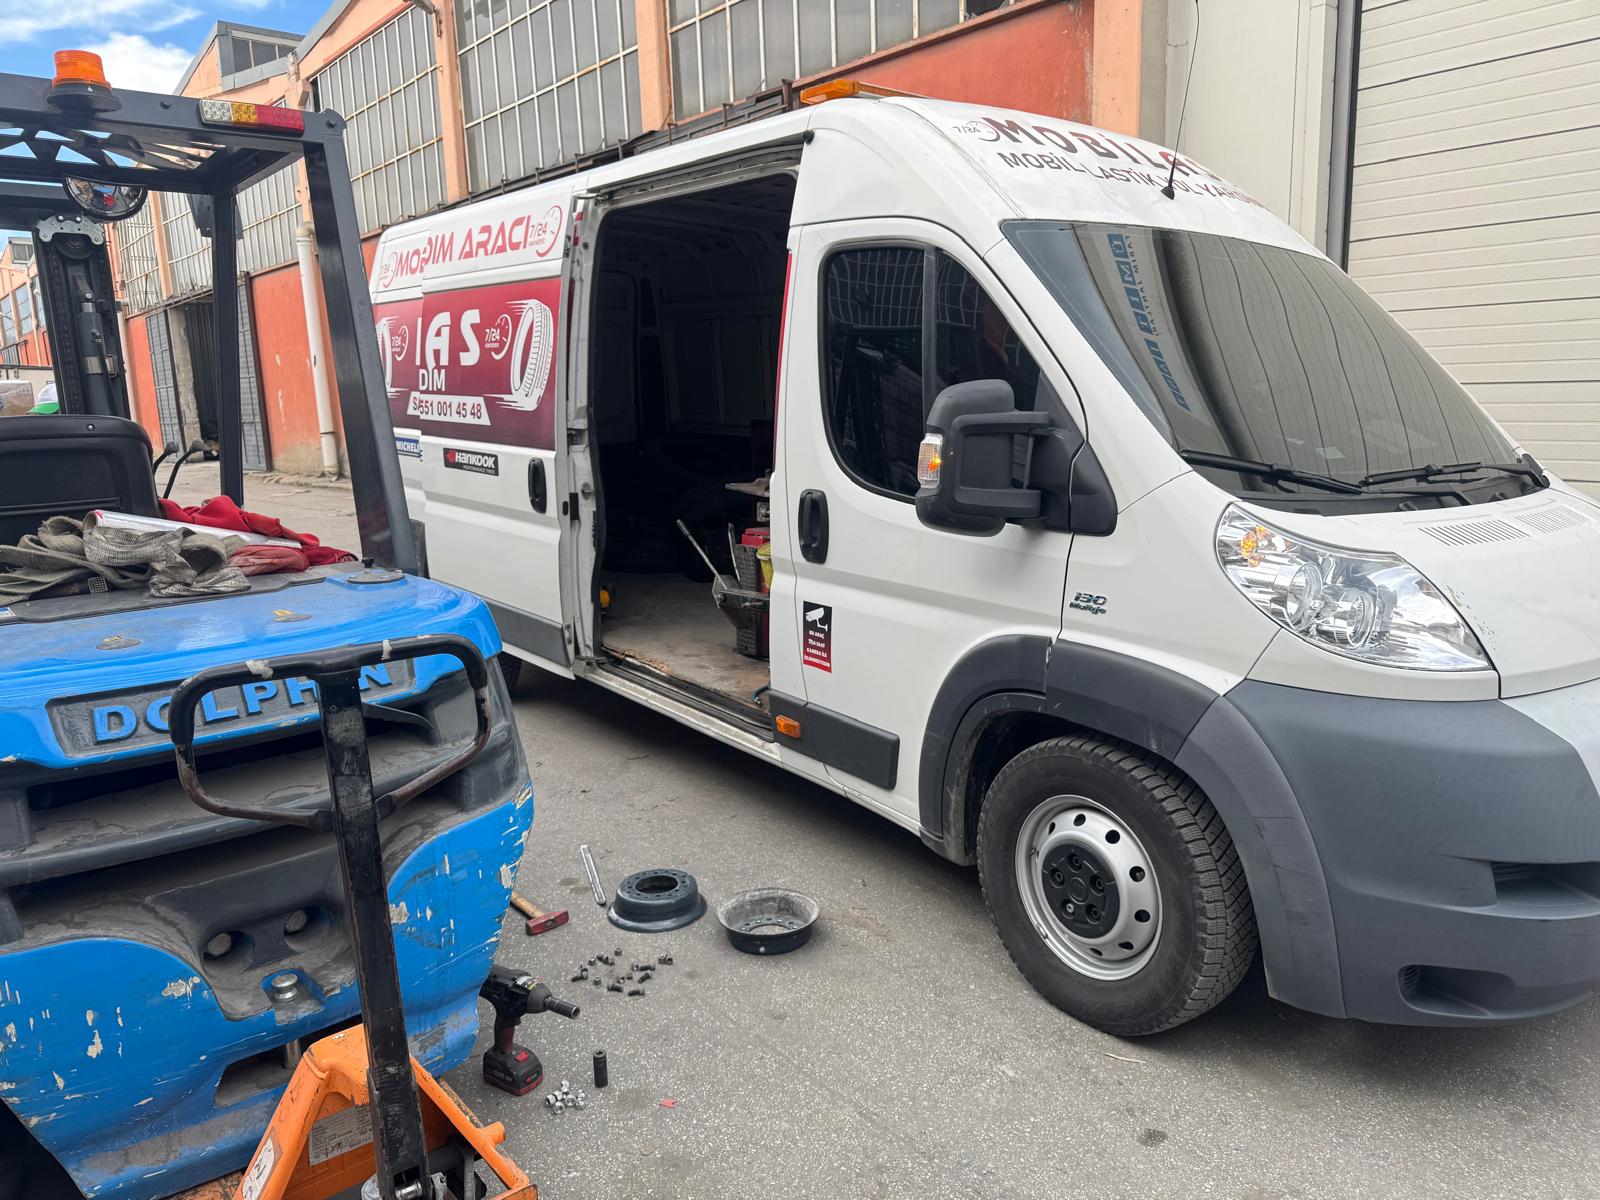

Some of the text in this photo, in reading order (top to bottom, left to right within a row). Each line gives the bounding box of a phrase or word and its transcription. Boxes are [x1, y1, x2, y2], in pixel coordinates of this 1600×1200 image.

[997, 152, 1086, 172] MOBİL
[458, 214, 531, 260] ARACI
[485, 327, 500, 342] 7/24
[437, 401, 452, 417] 001
[456, 402, 467, 418] 45
[470, 403, 482, 419] 48
[94, 664, 392, 742] DOLPHN
